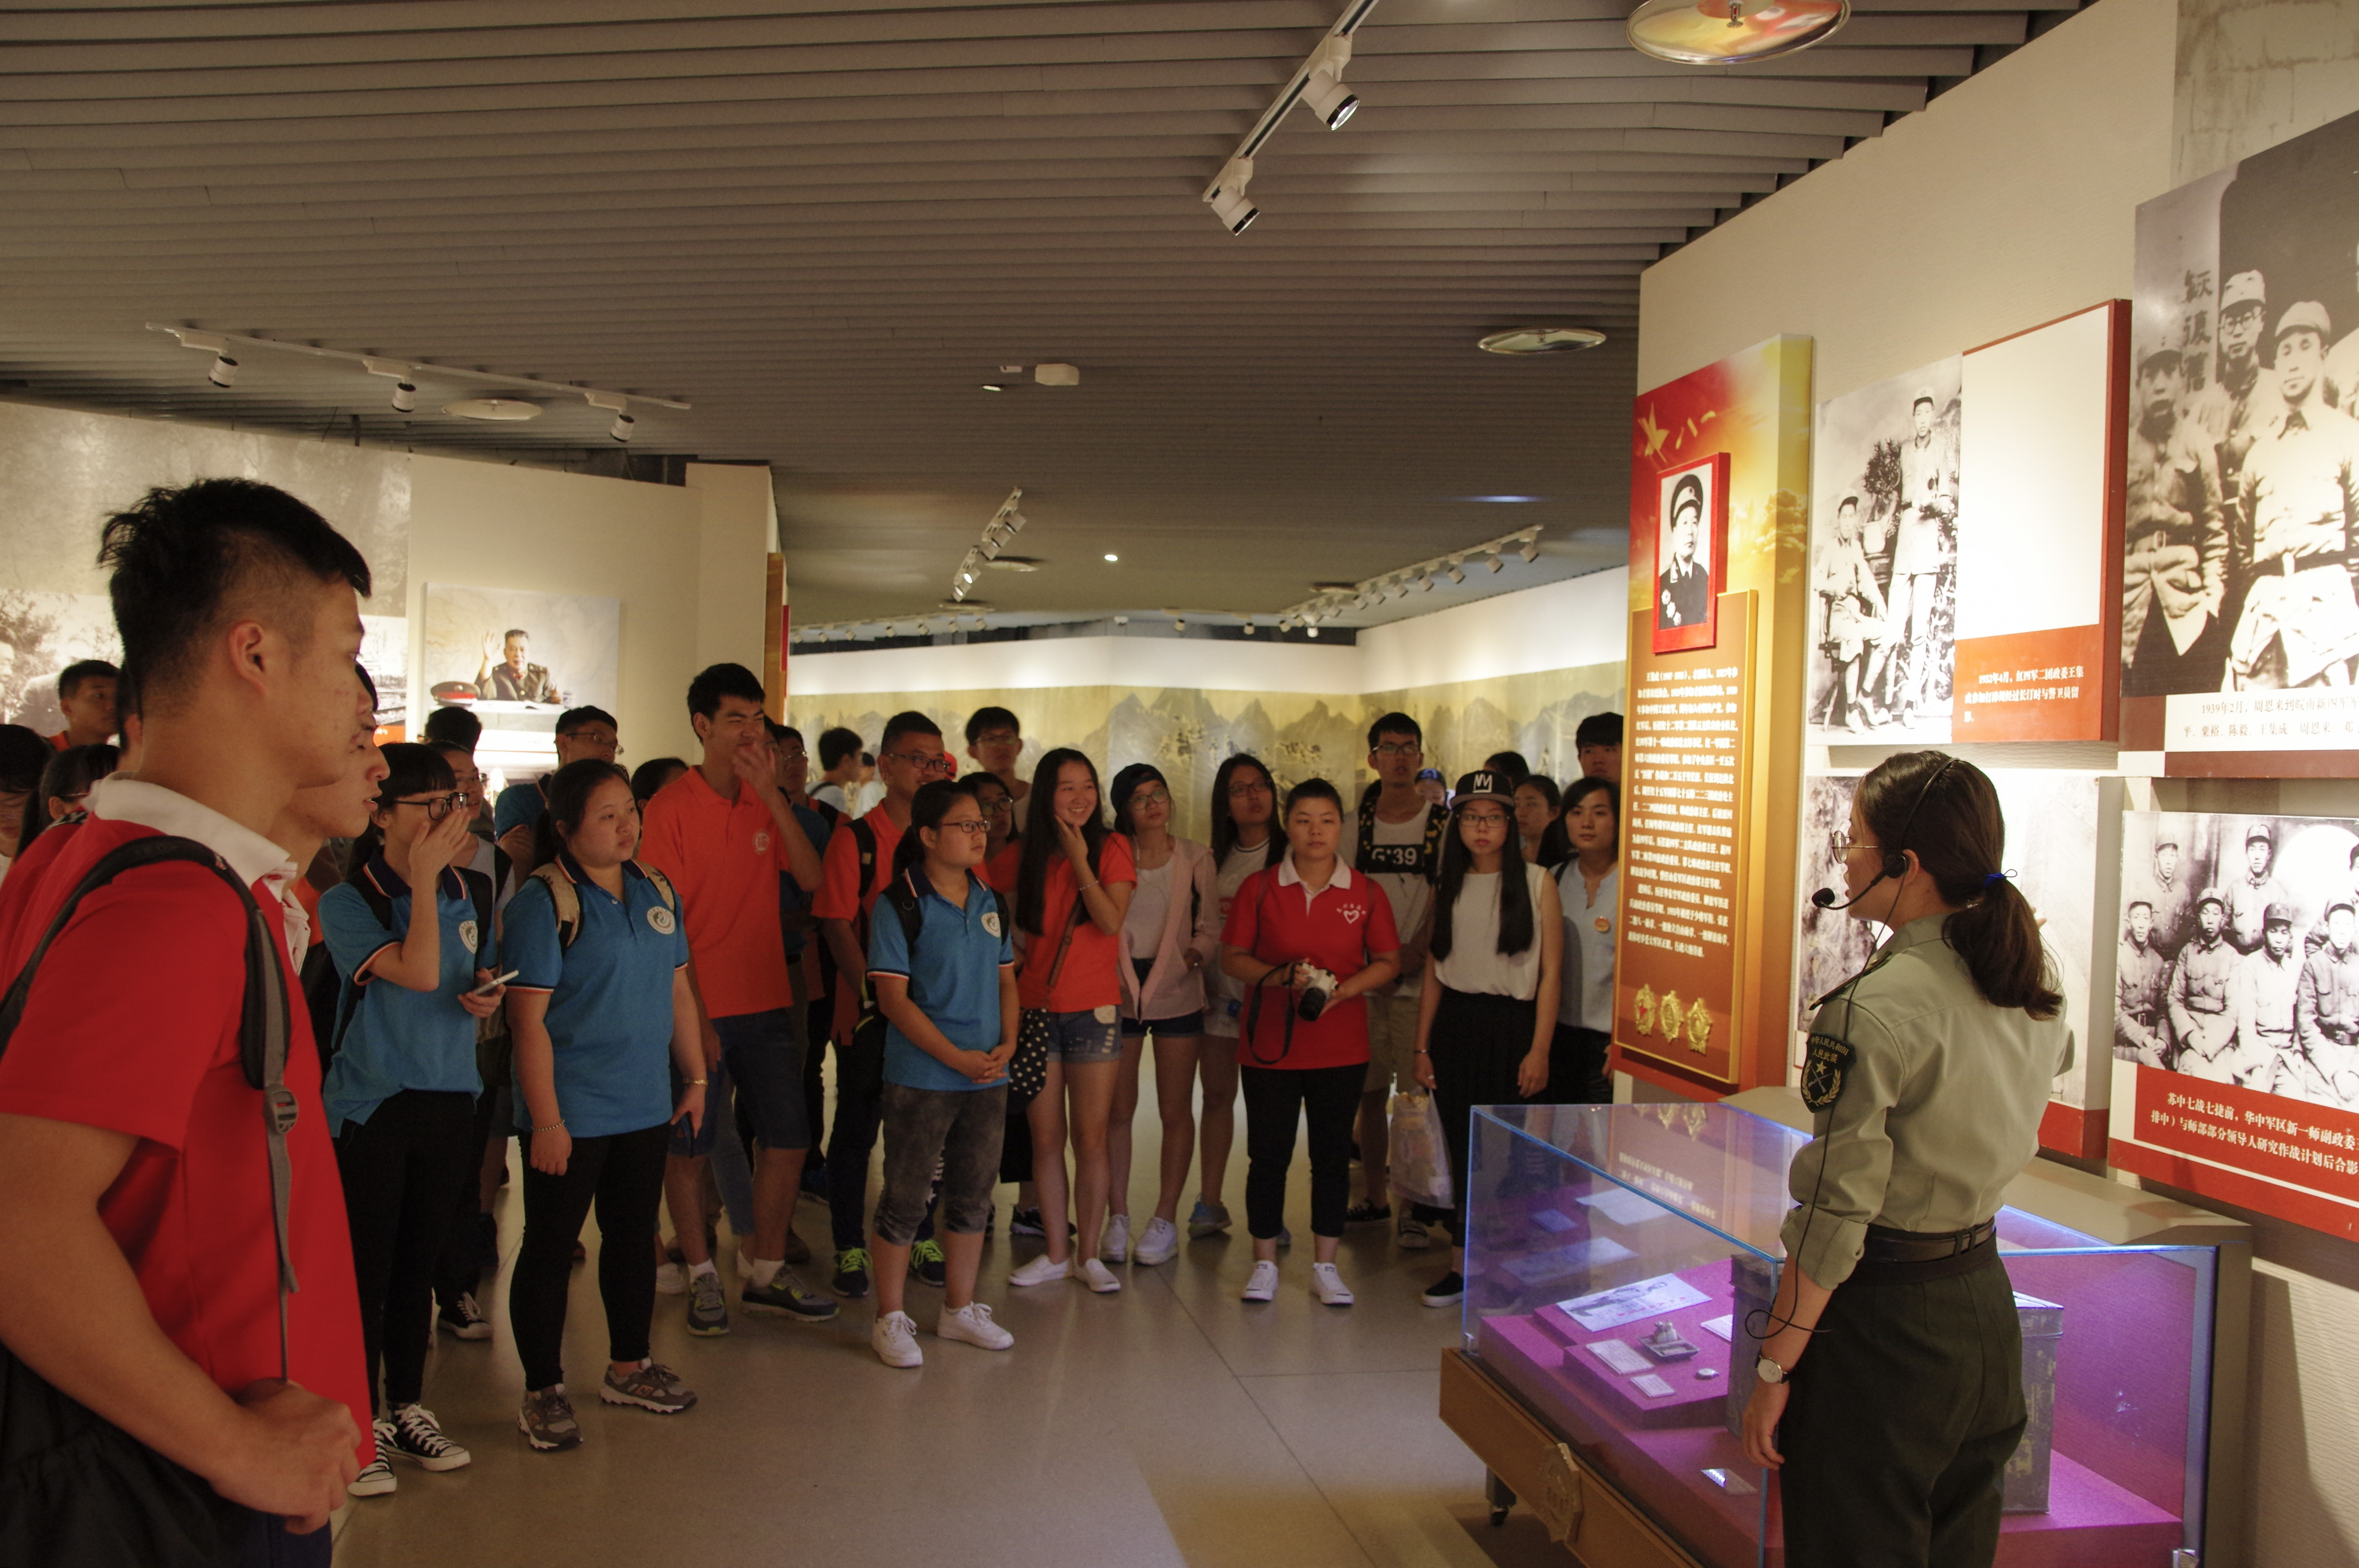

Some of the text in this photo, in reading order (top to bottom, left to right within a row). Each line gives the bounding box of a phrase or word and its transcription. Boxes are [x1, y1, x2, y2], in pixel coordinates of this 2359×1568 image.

[1811, 1036, 1849, 1056] 中华人民共和国
[1813, 1048, 1839, 1063] 人民武装
